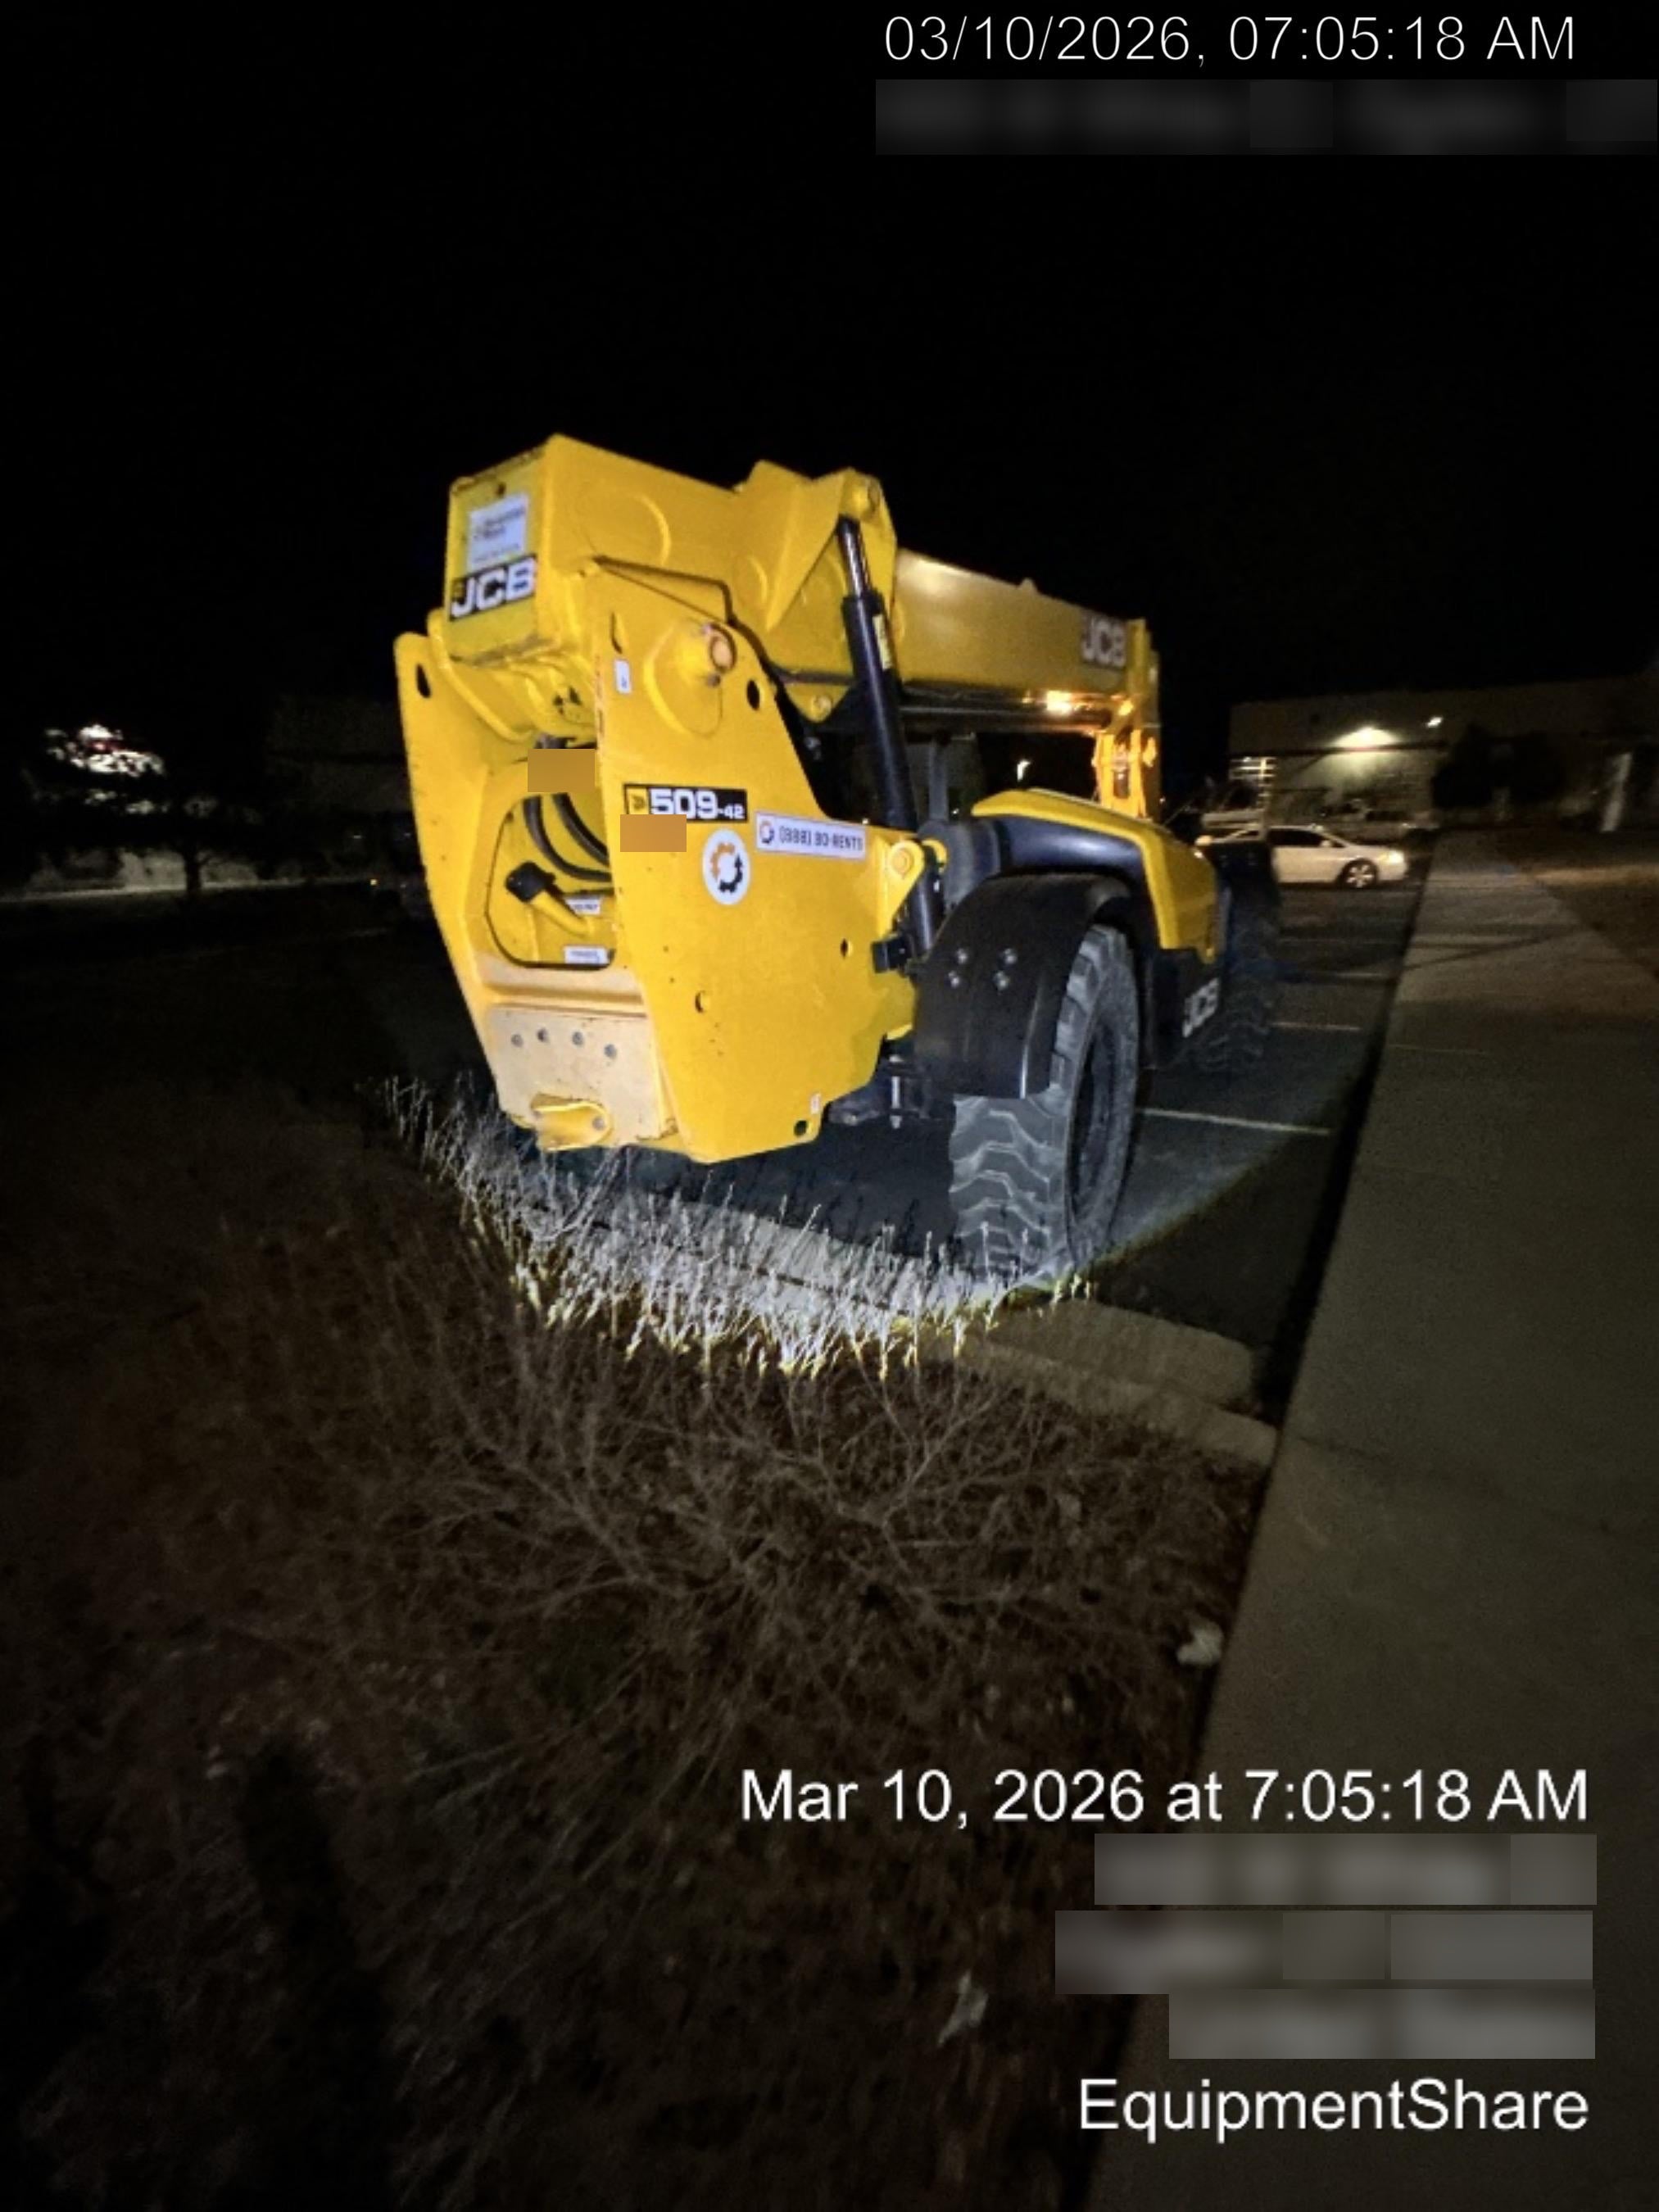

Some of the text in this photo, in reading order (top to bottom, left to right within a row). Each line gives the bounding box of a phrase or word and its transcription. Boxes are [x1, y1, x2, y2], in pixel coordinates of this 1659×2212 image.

[451, 557, 536, 619] JCB
[1081, 616, 1126, 668] JCB
[1181, 977, 1219, 1038] JCB
